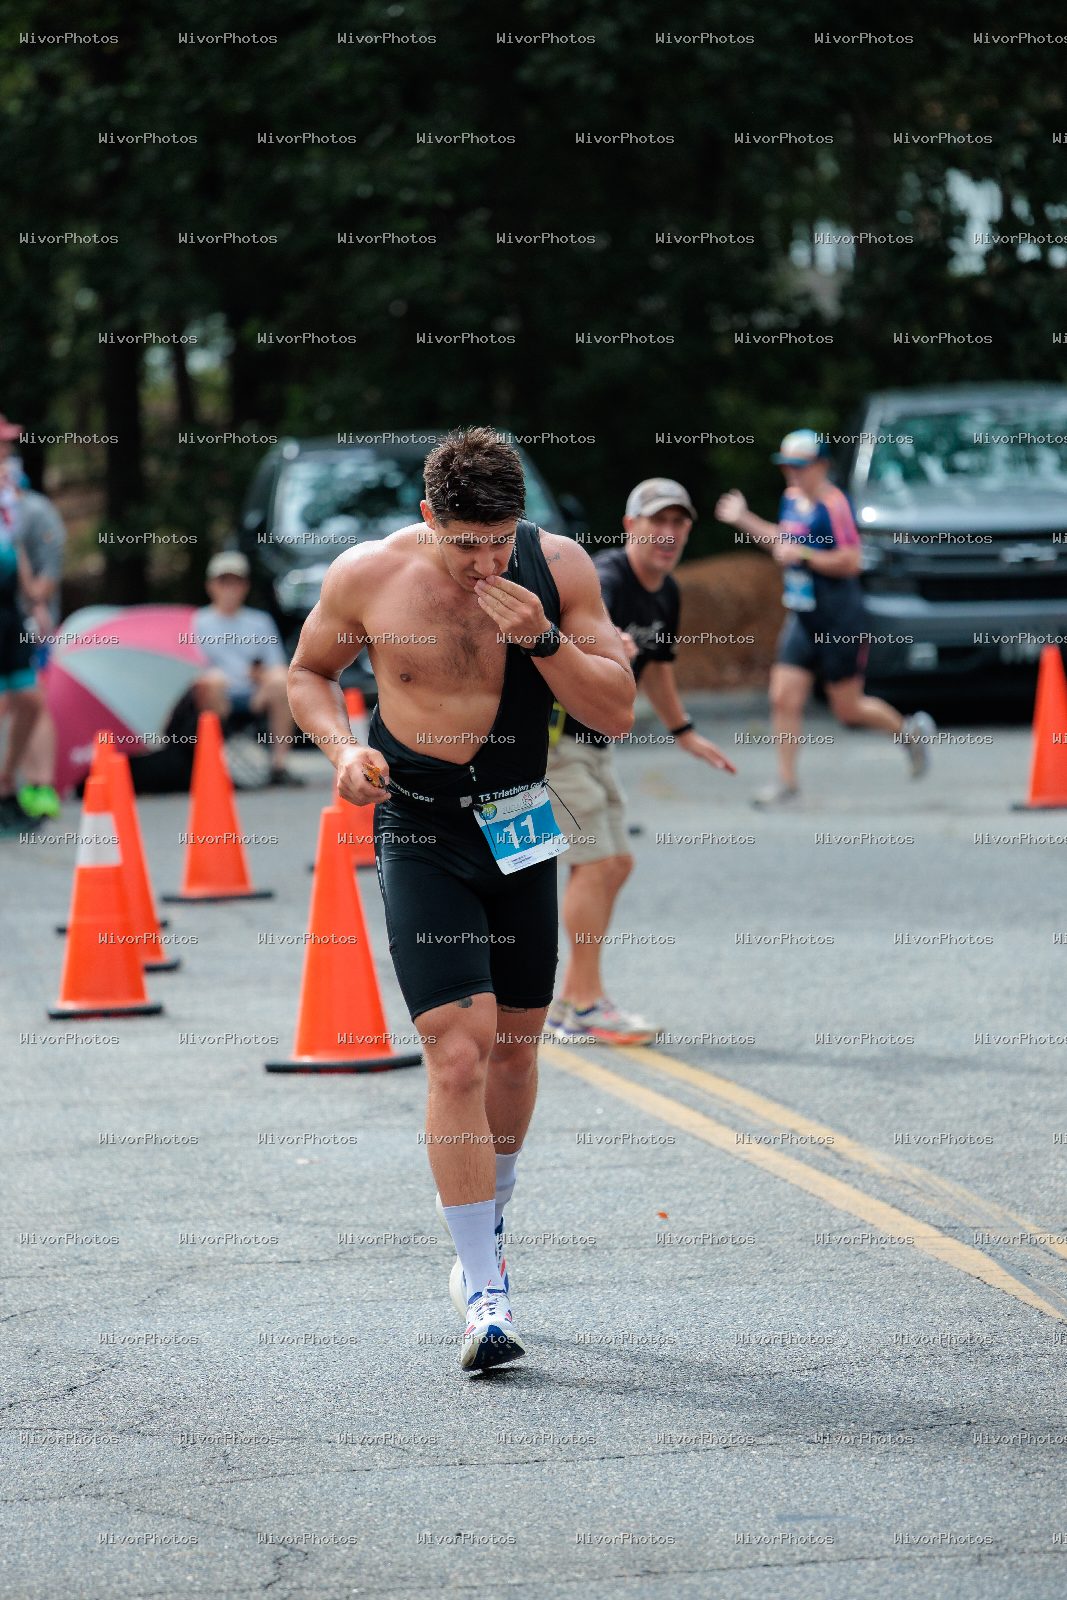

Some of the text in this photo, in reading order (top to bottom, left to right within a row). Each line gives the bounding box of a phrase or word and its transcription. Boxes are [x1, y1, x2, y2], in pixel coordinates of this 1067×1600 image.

[478, 794, 490, 802] T3
[493, 784, 529, 799] Triathlon
[503, 814, 536, 849] 11
